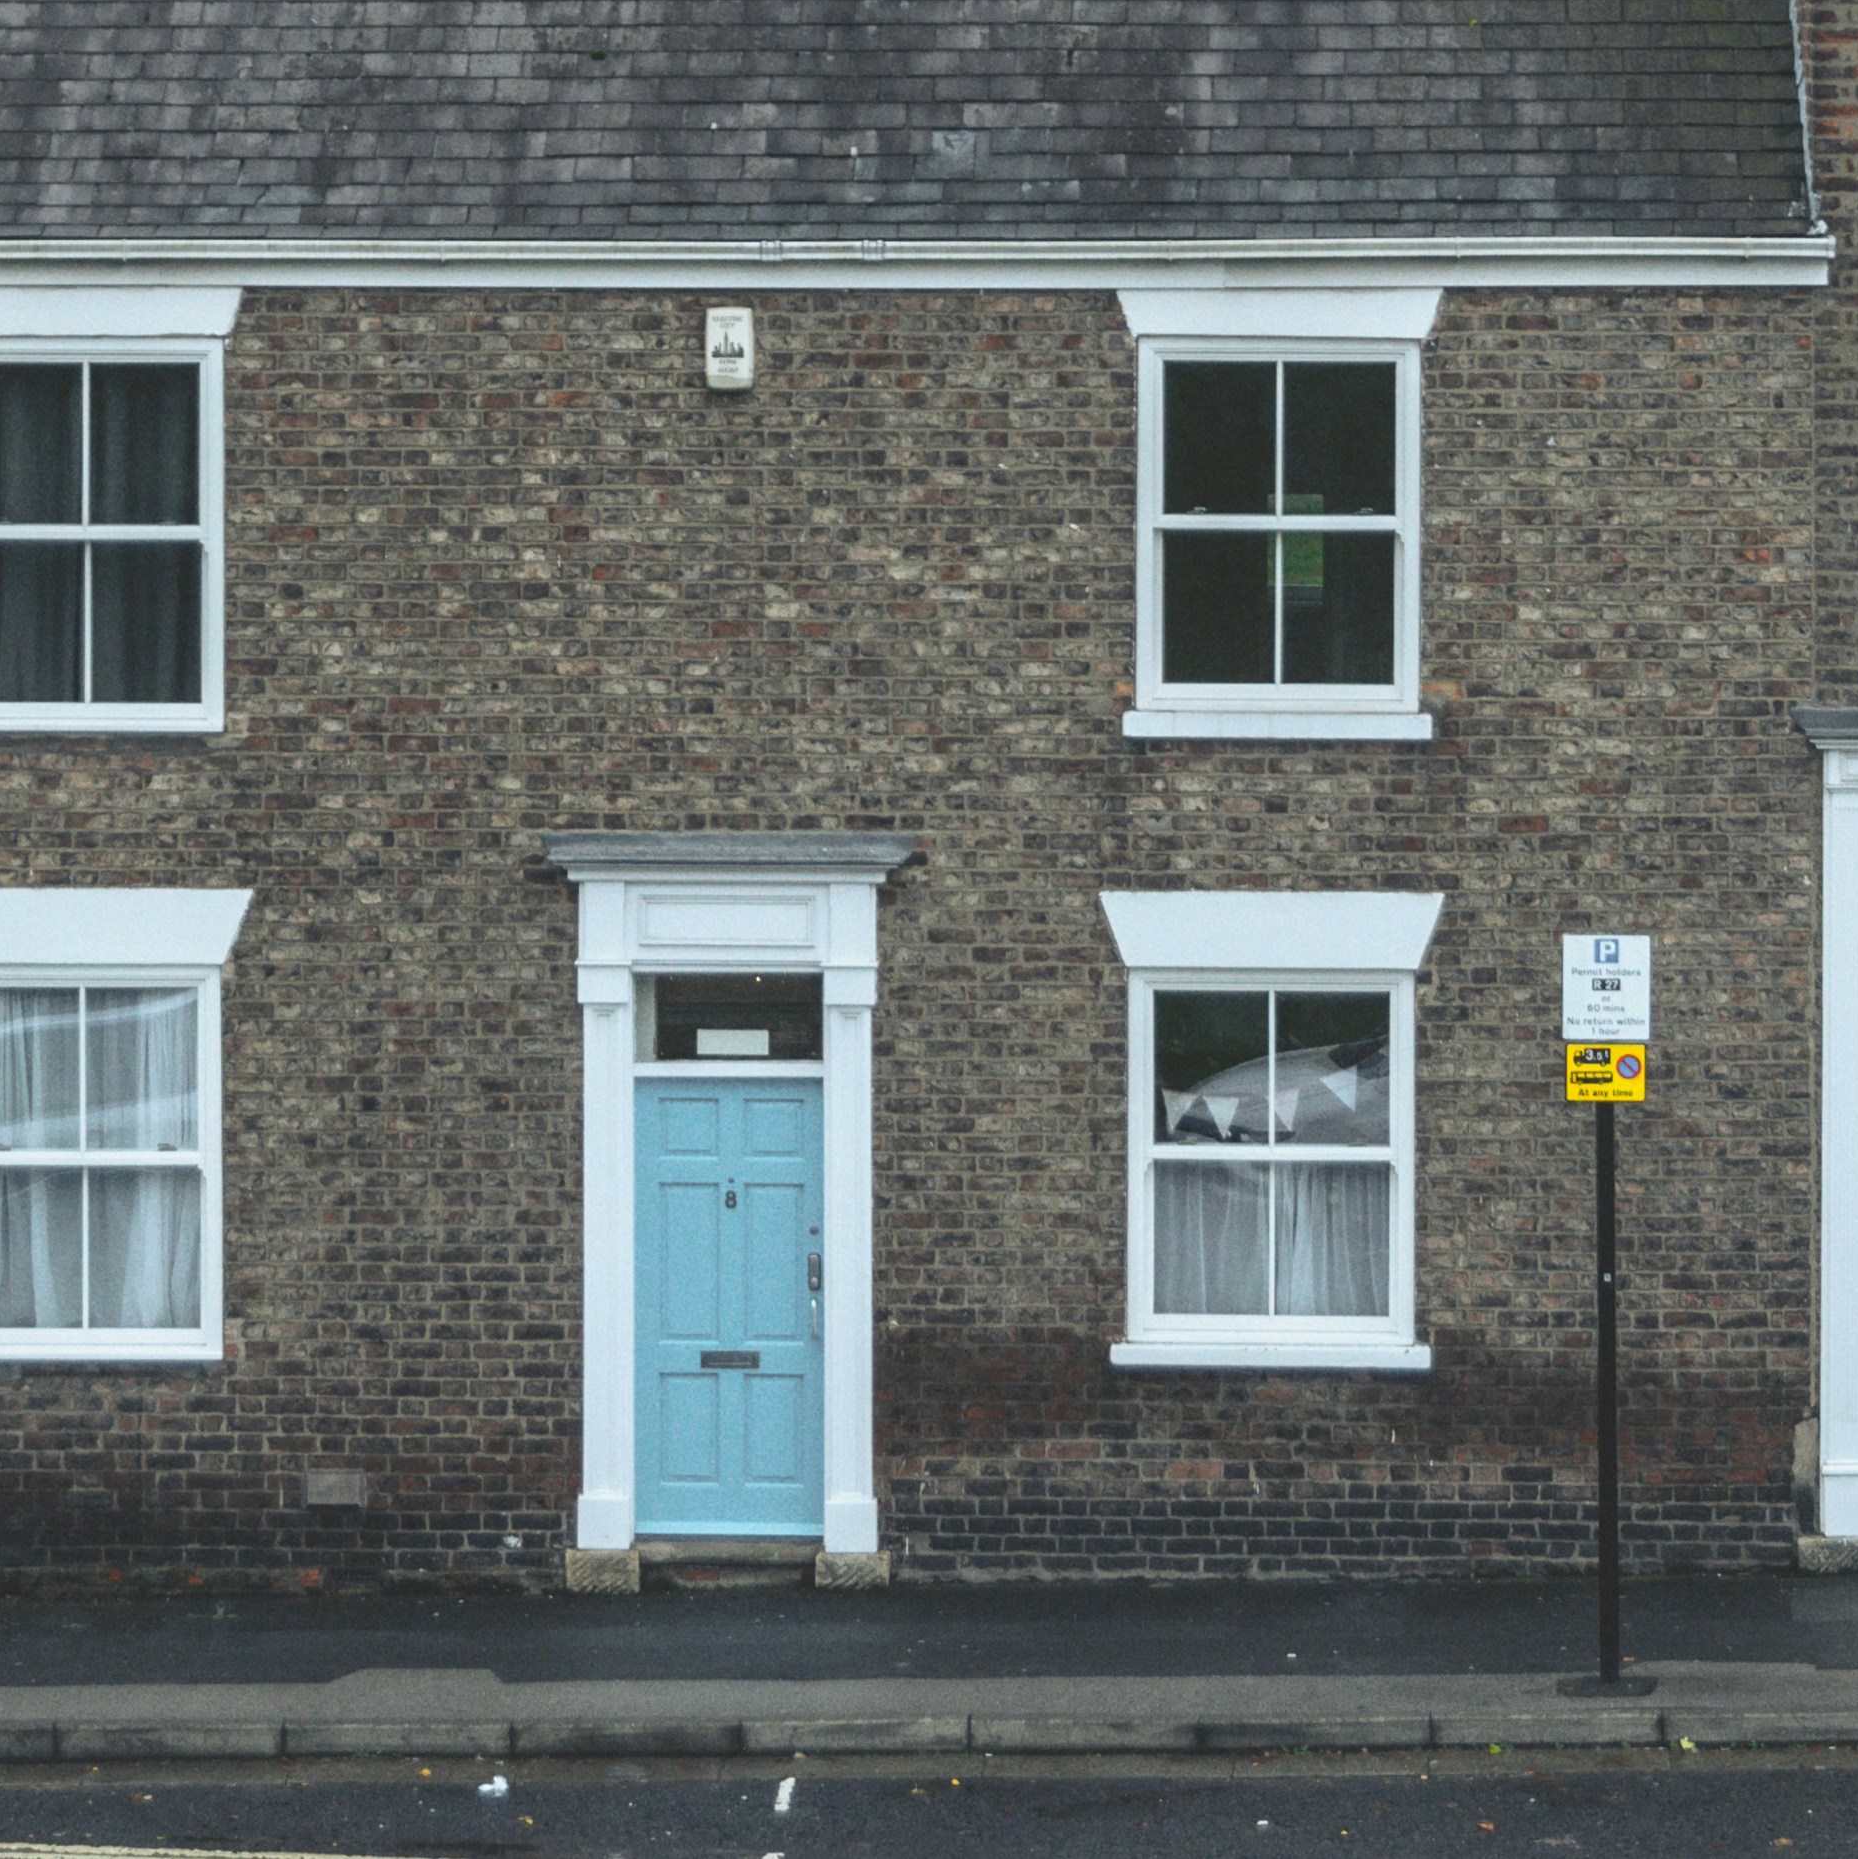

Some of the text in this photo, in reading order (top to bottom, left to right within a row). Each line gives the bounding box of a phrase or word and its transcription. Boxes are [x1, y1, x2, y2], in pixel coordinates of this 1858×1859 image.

[1599, 941, 1616, 962] P
[1572, 967, 1641, 976] Permit holders
[1593, 980, 1619, 989] R 27
[1567, 1017, 1645, 1026] No return within
[1593, 1090, 1608, 1098] any
[725, 1190, 737, 1209] 8
